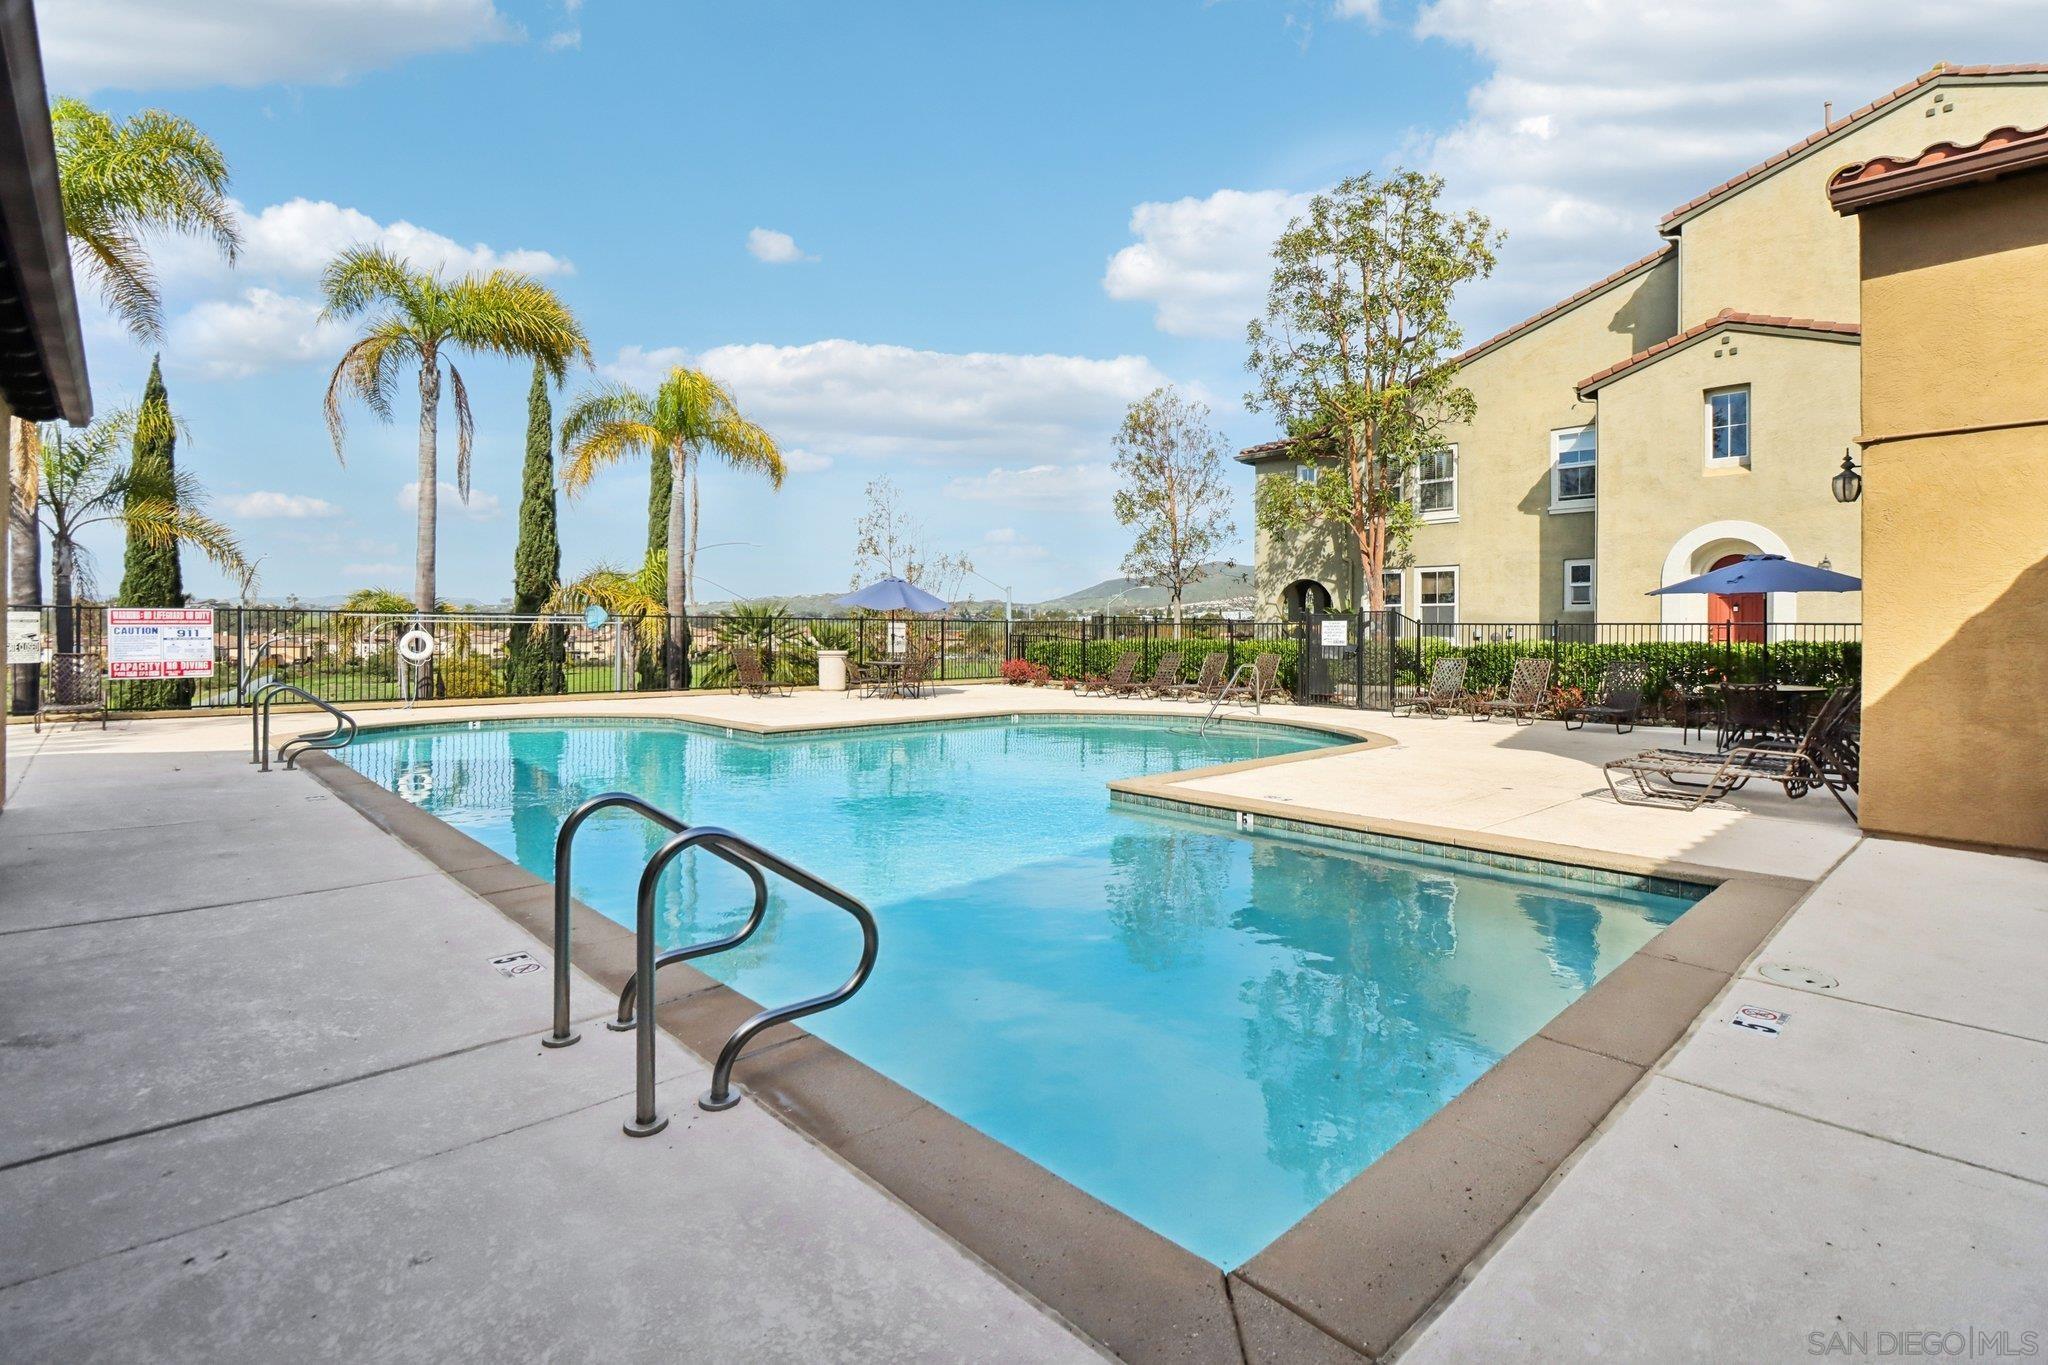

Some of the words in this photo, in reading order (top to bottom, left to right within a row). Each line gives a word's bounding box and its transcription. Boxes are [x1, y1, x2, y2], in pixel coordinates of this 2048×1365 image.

[153, 610, 185, 620] LIFEGUARD
[194, 610, 210, 620] DUTY
[113, 626, 159, 635] CAUTION
[176, 629, 199, 637] 911
[113, 662, 160, 671] CAPACITY
[166, 661, 178, 671] NO
[182, 661, 208, 670] DIVING
[1732, 1019, 1777, 1033] 5
